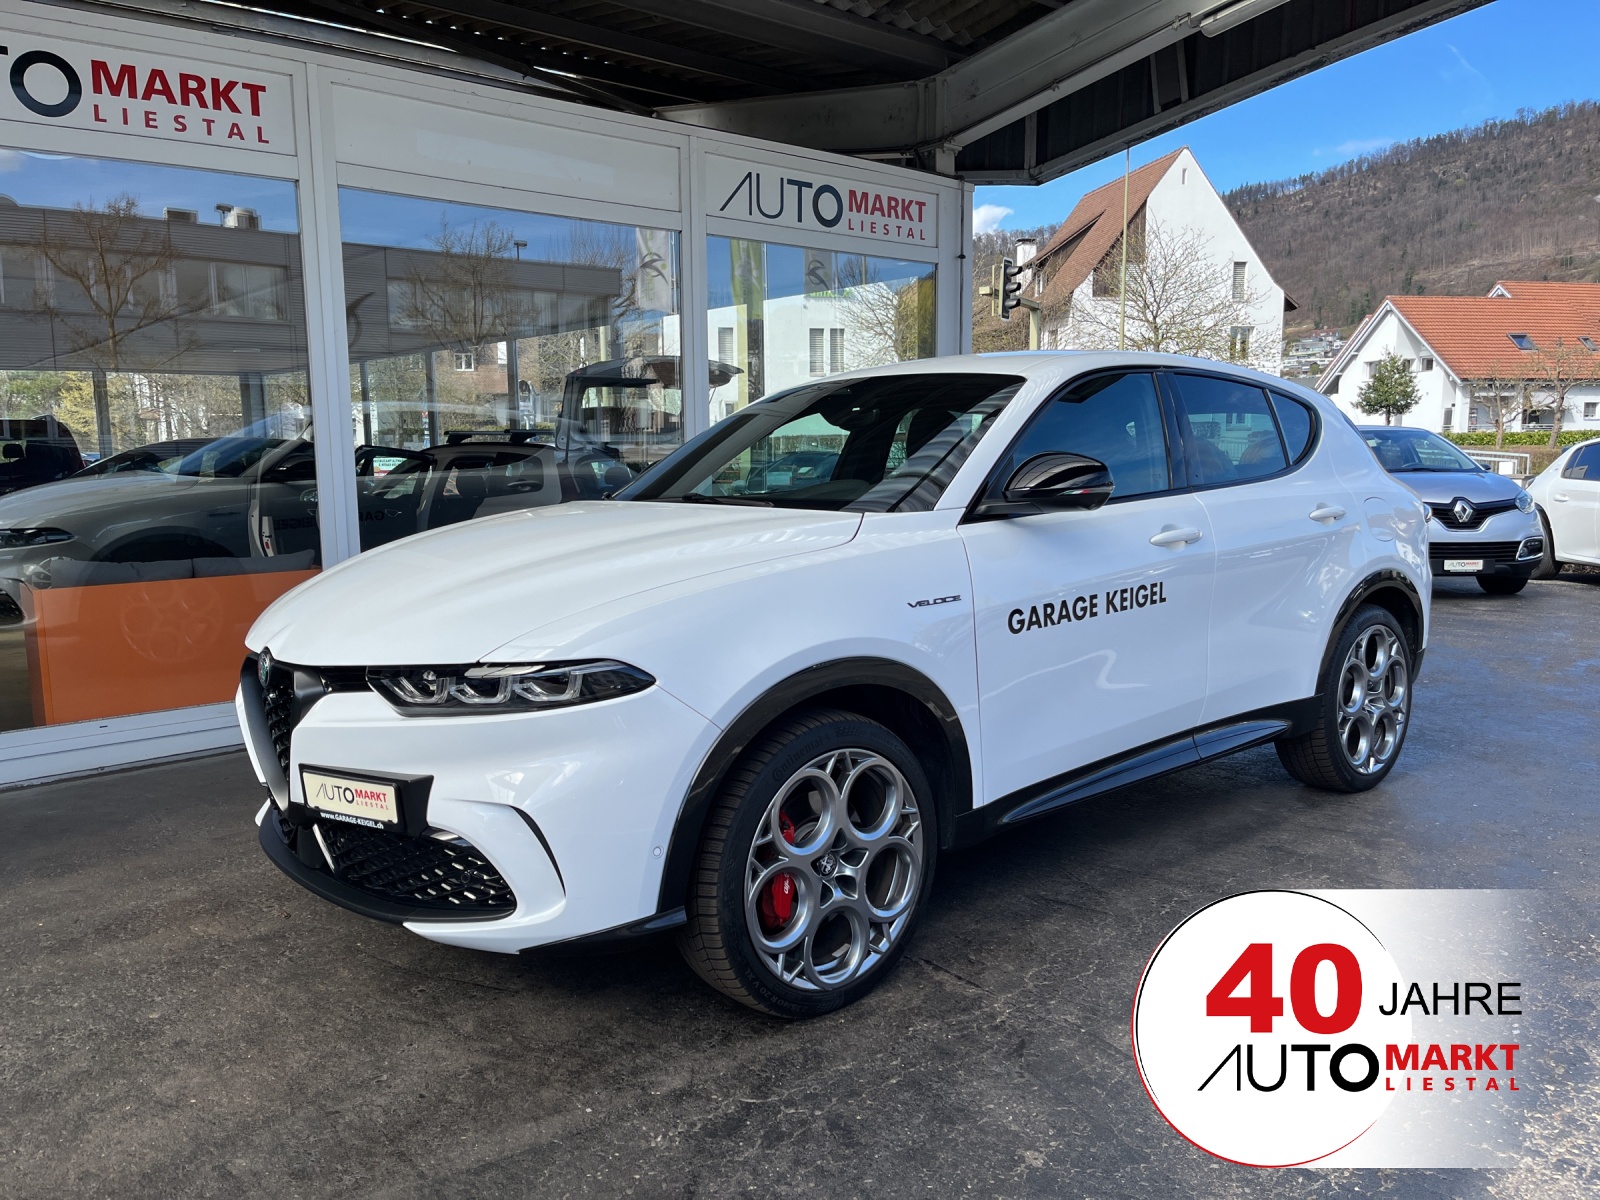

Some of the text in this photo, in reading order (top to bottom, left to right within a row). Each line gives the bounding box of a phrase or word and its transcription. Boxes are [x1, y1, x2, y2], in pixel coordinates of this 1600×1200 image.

[90, 59, 267, 117] MARKT
[93, 104, 270, 144] LIESTAL
[719, 171, 926, 228] AUTO MARKT
[848, 218, 926, 241] LIESTAL
[907, 595, 962, 608] VELOCE
[1007, 581, 1167, 634] GARAGE KEIGEL
[316, 783, 387, 804] AUTO MARKT
[356, 800, 389, 811] LIESTAL
